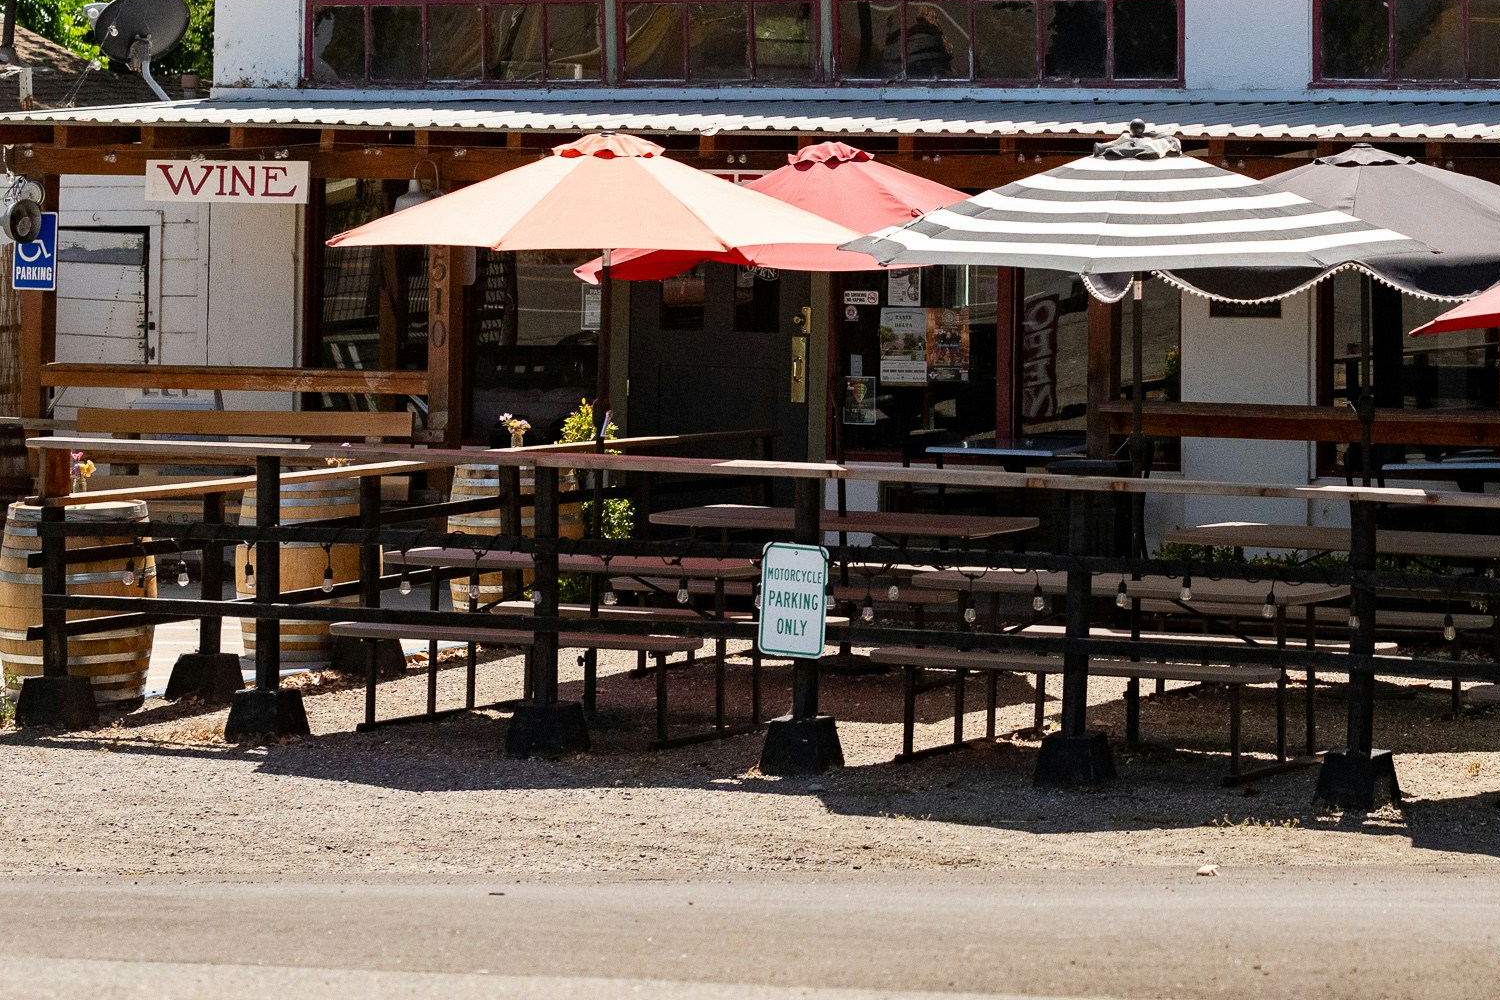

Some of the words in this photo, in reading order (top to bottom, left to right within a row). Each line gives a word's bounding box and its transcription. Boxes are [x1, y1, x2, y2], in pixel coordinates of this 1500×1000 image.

[156, 164, 298, 197] WINE
[16, 266, 52, 281] PARKING
[746, 265, 775, 279] OPEN
[431, 245, 447, 348] 510
[767, 567, 822, 584] MOTORCYCLE
[768, 590, 818, 610] PARKING
[777, 618, 807, 636] ONLY
